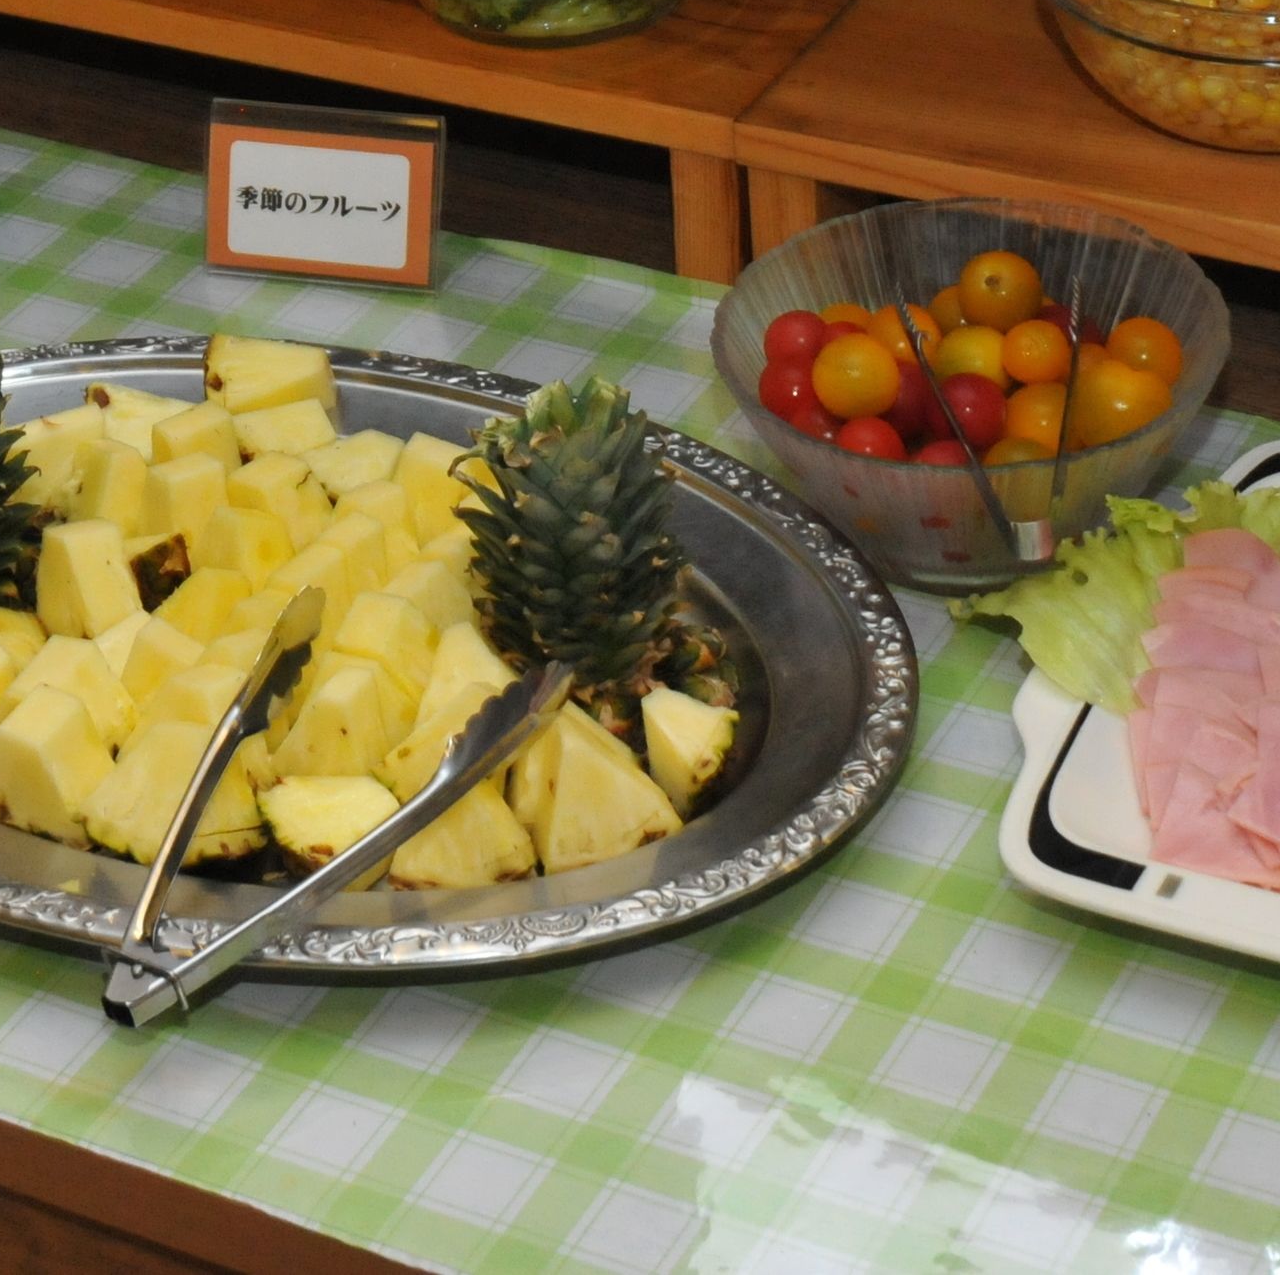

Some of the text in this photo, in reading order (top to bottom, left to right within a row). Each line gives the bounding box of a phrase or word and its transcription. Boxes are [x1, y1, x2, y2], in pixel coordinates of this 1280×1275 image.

[235, 185, 401, 222] 季節のフルーツ
